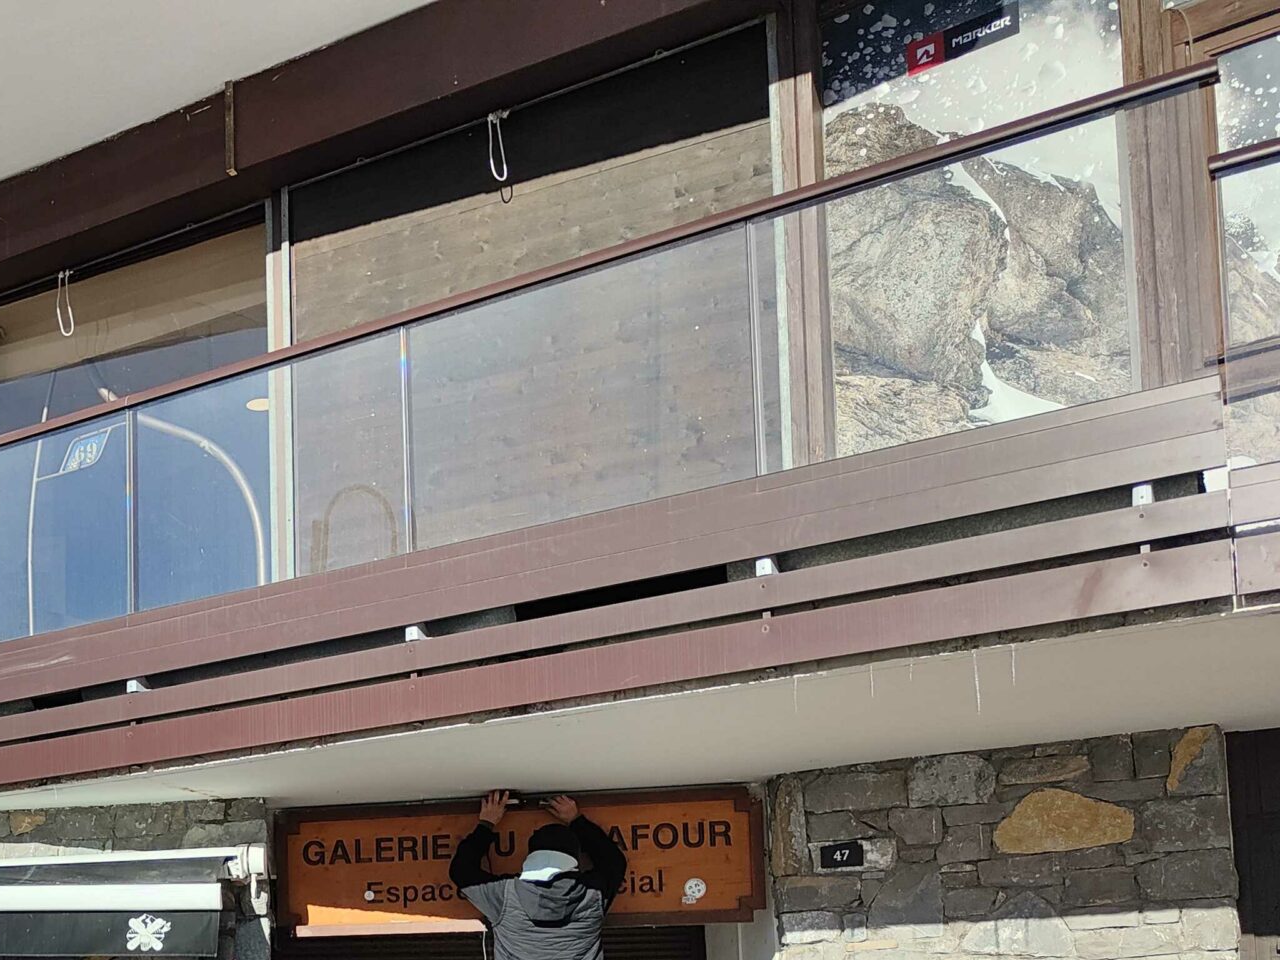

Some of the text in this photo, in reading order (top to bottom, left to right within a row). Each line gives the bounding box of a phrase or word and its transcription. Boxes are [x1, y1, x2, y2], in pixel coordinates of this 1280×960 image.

[951, 14, 1011, 48] MARKER
[302, 820, 732, 866] GALERIE U AFOUR
[833, 848, 849, 862] 47
